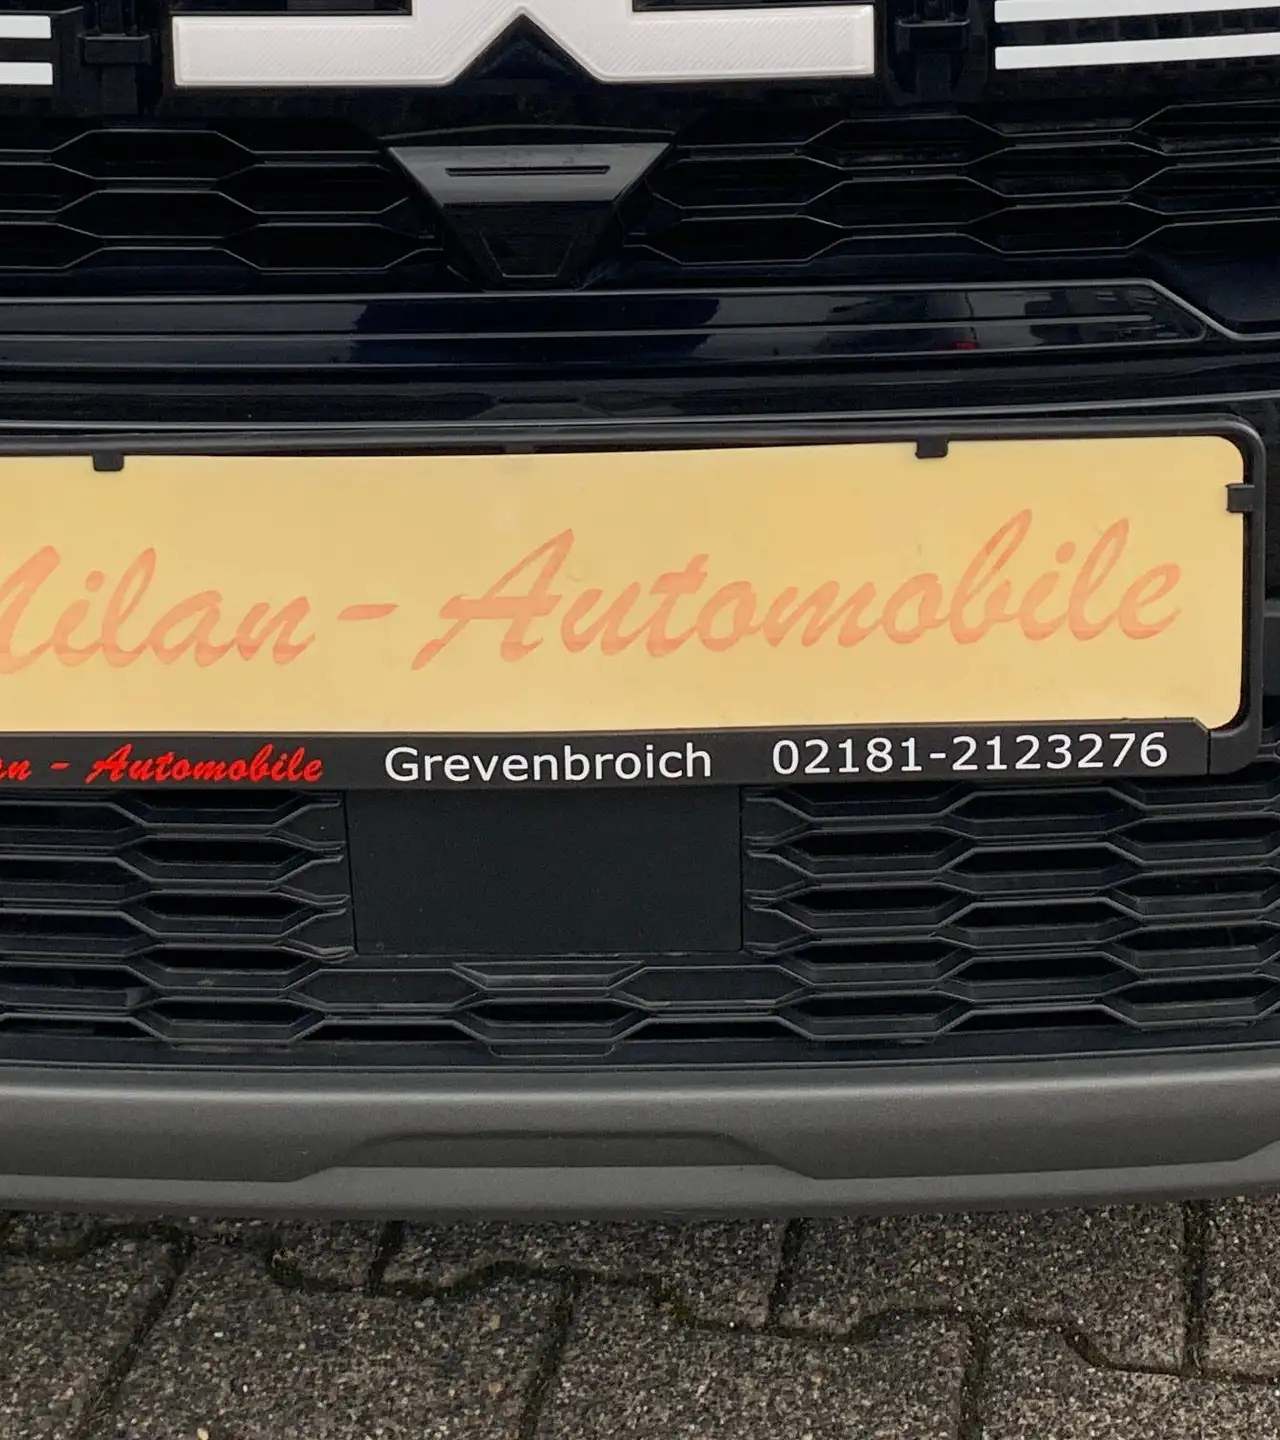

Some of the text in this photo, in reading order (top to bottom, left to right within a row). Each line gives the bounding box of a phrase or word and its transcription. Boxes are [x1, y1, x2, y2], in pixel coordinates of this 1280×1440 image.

[410, 507, 1184, 671] Automobile
[85, 743, 324, 784] Automobile
[383, 742, 714, 783] Grevenbroich
[771, 730, 1170, 776] 02181-2123276
